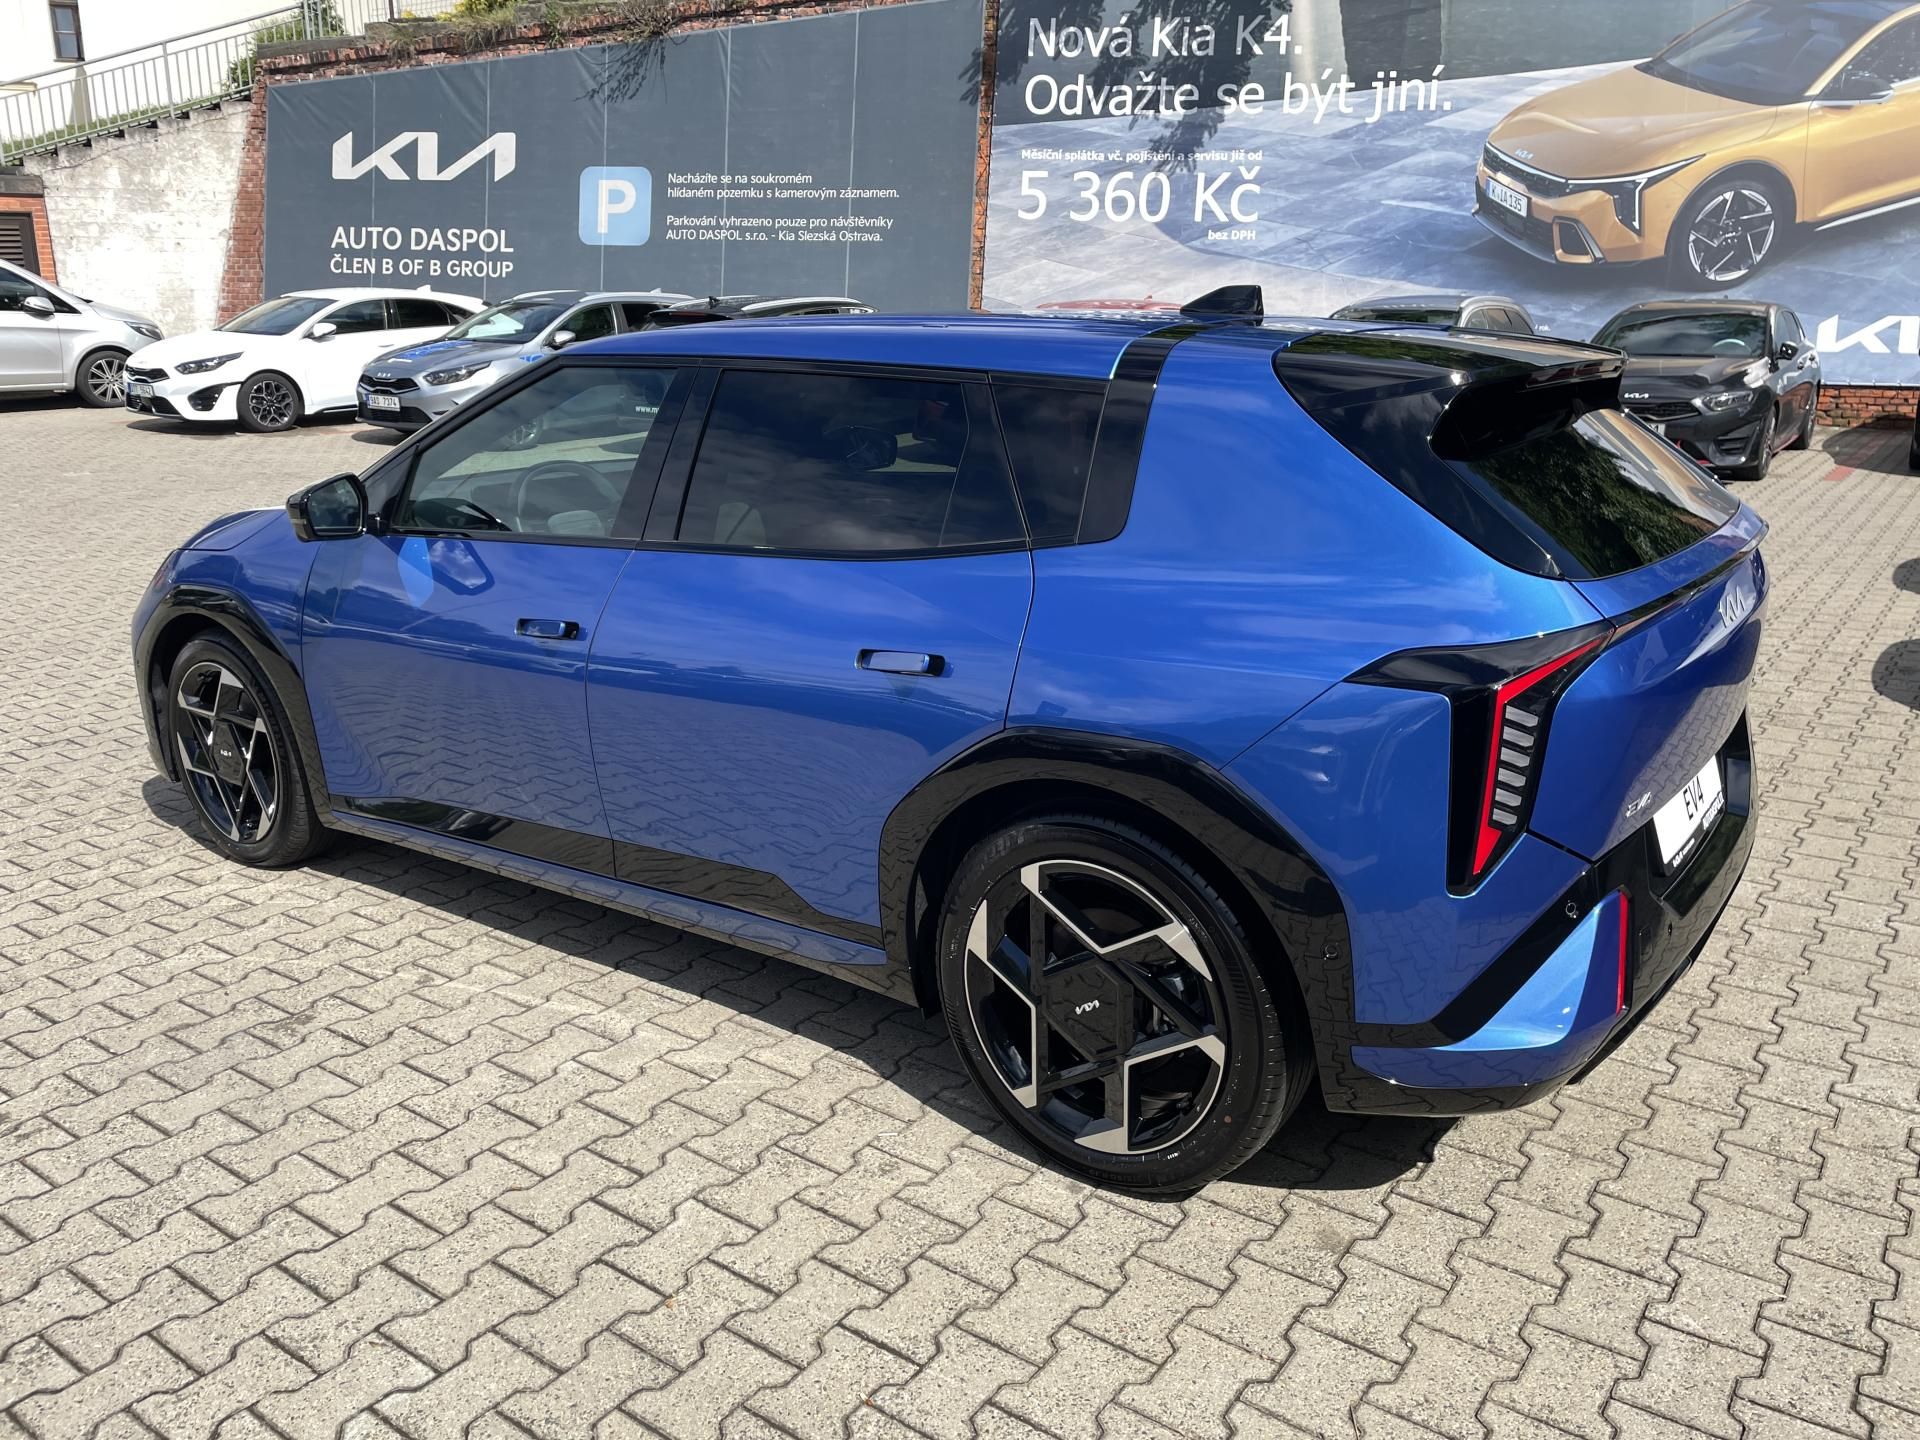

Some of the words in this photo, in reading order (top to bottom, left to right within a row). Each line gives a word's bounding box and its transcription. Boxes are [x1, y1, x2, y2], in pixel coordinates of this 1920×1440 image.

[1027, 15, 1133, 58] Nová
[1152, 16, 1215, 57] Kia
[1235, 14, 1303, 55] K4.
[1024, 71, 1199, 117] Odvažte
[1216, 80, 1265, 116] se
[1283, 68, 1355, 124] být
[1365, 64, 1452, 124] jiní.
[331, 131, 516, 182] KIA
[1021, 149, 1063, 161] Měsíční
[1064, 149, 1105, 163] splátka
[1107, 150, 1123, 161] vč.
[1125, 150, 1175, 163] pojištění
[1177, 153, 1185, 161] a
[1187, 150, 1228, 161] servisu
[1230, 150, 1246, 163] již
[1248, 150, 1263, 161] od
[668, 173, 718, 184] Nacházíte
[720, 175, 732, 184] se
[734, 175, 749, 184] na
[750, 173, 812, 184] soukromém
[597, 179, 637, 234] P
[667, 187, 715, 198] hlídaném
[717, 189, 764, 200] pozemku
[766, 190, 773, 198] s
[775, 188, 837, 200] kamerovým
[839, 187, 900, 198] záznamem.
[1017, 170, 1050, 221] 5
[1069, 170, 1171, 223] 360
[1193, 166, 1261, 223] Kč
[666, 215, 717, 226] Parkování
[719, 216, 773, 229] vyhrazeno
[775, 218, 808, 229] pouze
[809, 219, 828, 229] pro
[830, 215, 894, 230] návštěvníky
[666, 230, 697, 241] AUTO
[699, 230, 743, 241] DASPOL
[745, 232, 769, 241] s.r.o.
[778, 230, 795, 241] Kia
[798, 230, 836, 242] Slezská
[839, 231, 883, 242] Ostrava.
[1207, 229, 1229, 240] bez
[1231, 230, 1256, 241] DPH
[330, 226, 403, 250] AUTO
[410, 227, 514, 253] DASPOL
[330, 253, 377, 274] ČLEN
[382, 258, 394, 275] B
[399, 258, 424, 276] OF
[429, 259, 441, 276] B
[446, 260, 514, 278] GROUP
[1816, 314, 1920, 354] KI
[1683, 775, 1704, 821] EV4
